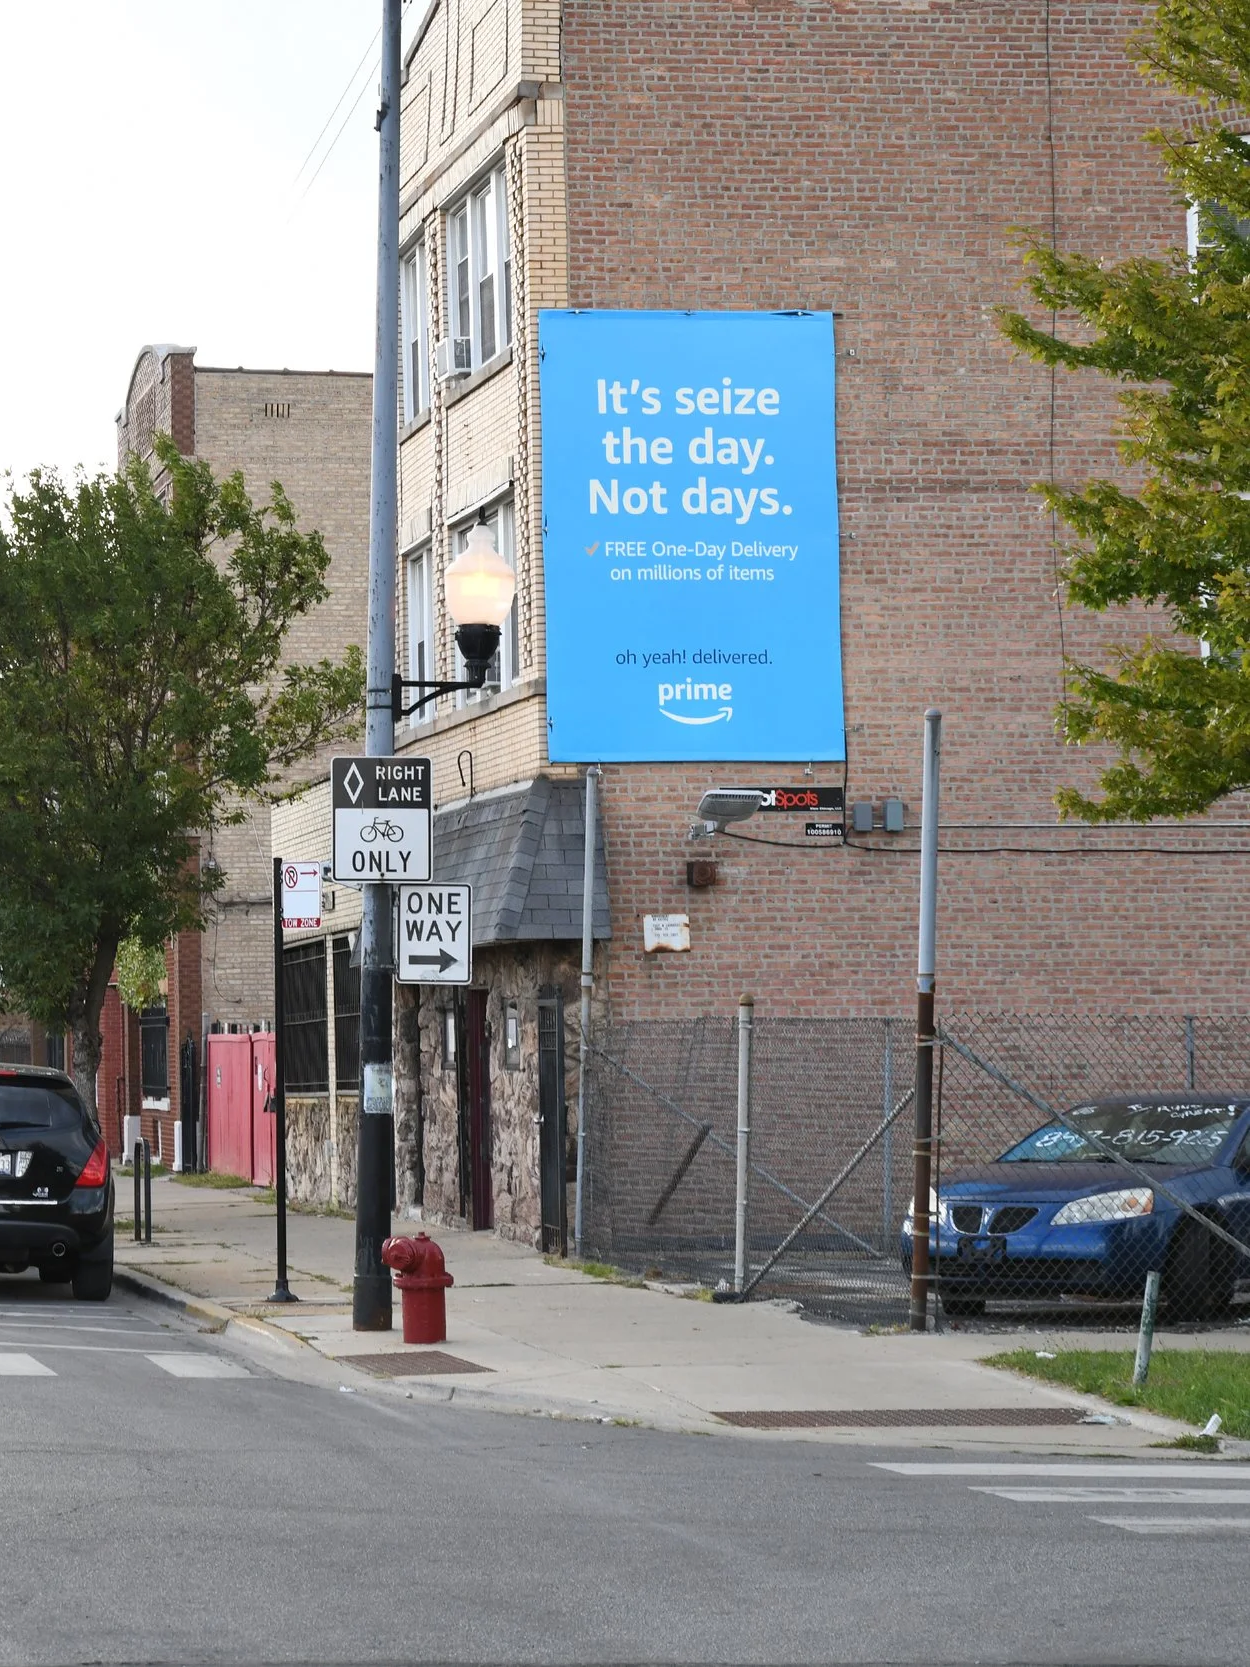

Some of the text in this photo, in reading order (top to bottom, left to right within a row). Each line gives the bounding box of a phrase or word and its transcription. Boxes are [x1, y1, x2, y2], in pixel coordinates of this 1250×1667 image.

[597, 377, 781, 416] It's seize
[602, 427, 775, 475] the day.
[589, 477, 793, 525] Not days.
[605, 541, 799, 561] FREE One-Day Delivery
[610, 564, 775, 581] on millions of items
[616, 649, 774, 669] oh yeah! delivered.
[658, 677, 733, 706] prime
[375, 765, 425, 780] RIGHT
[378, 786, 422, 802] LANE
[761, 789, 819, 809] otSpots
[352, 850, 412, 873] ONLY
[406, 892, 462, 915] ONE
[285, 918, 318, 928] TOW ZONE
[405, 920, 463, 942] WAY
